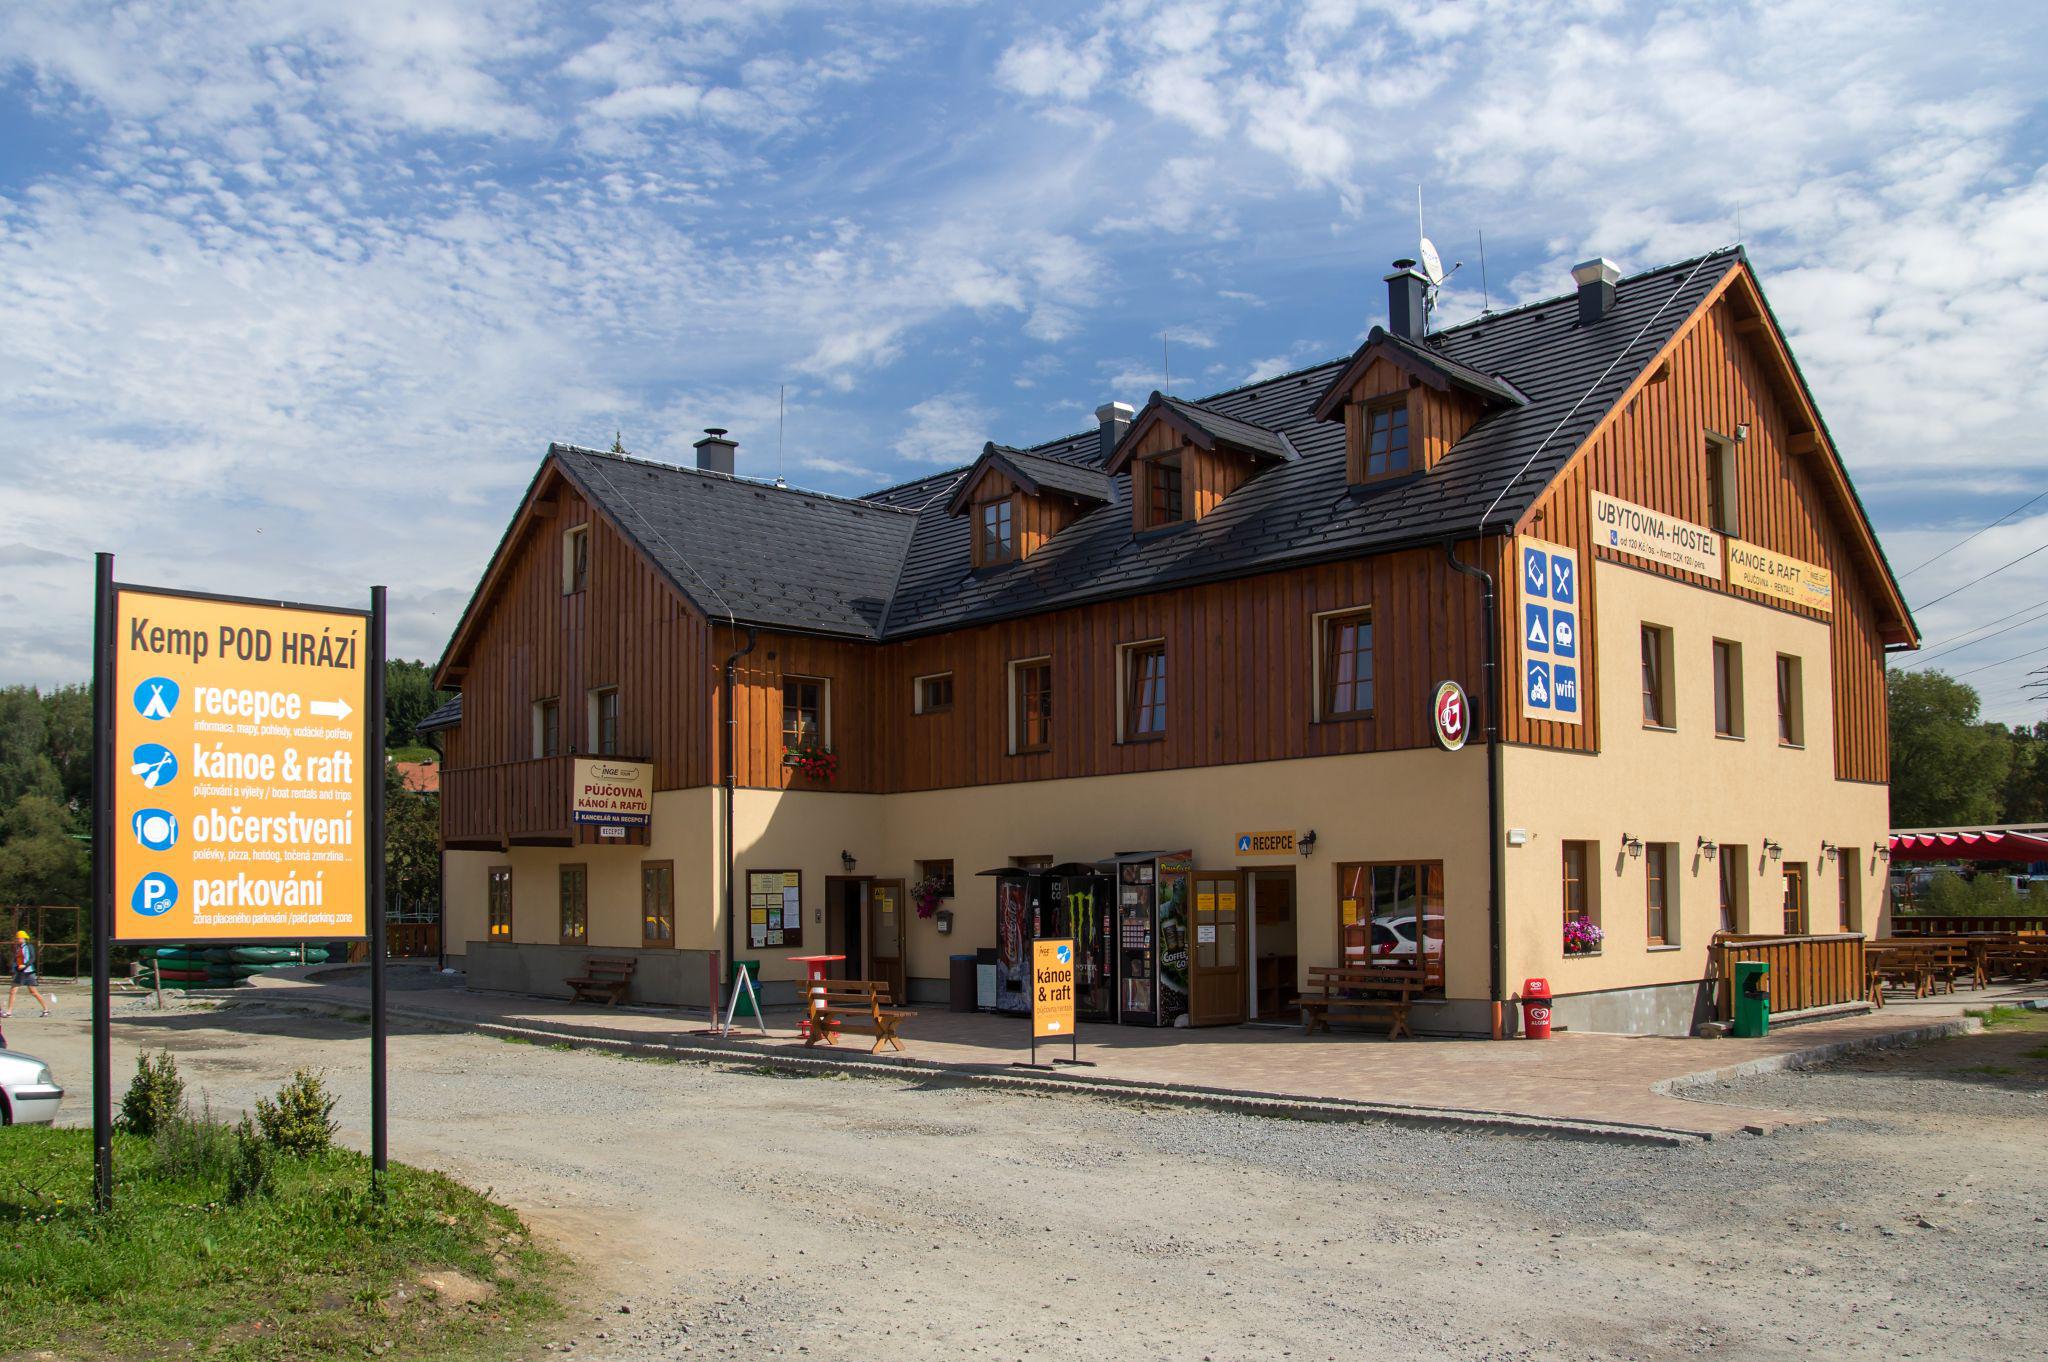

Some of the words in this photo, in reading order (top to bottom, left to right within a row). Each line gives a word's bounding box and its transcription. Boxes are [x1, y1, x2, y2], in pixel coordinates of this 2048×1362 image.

[1731, 548, 1766, 572] KANOE
[1777, 564, 1800, 583] RAFT
[131, 617, 208, 663] Kemp
[219, 625, 271, 662] POD
[282, 626, 358, 669] HRÁZÍ
[1556, 679, 1575, 699] wifi
[194, 686, 301, 724] recepce
[193, 742, 275, 780] kánoe
[281, 748, 302, 781] &
[307, 750, 353, 784] raft
[234, 788, 239, 796] a
[272, 787, 289, 798] boat
[291, 788, 317, 799] rentals
[319, 789, 333, 800] and
[335, 789, 352, 802] trips
[585, 783, 643, 798] PŮJČOVNA
[578, 797, 608, 808] KÁNOÍ
[611, 800, 617, 809] A
[620, 800, 648, 811] RAFTŮ
[581, 813, 611, 821] KANCELÁŘ
[193, 806, 353, 845] občerstvení
[1253, 836, 1293, 850] RECEPCE
[284, 850, 310, 861] točená
[312, 851, 344, 862] zmrzlina
[193, 871, 323, 915] parkování
[252, 912, 287, 925] parkování
[308, 912, 334, 926] parking
[336, 913, 352, 923] zone
[1037, 967, 1071, 984] kánoe
[1038, 987, 1047, 1001] &
[1050, 985, 1071, 1001] raft
